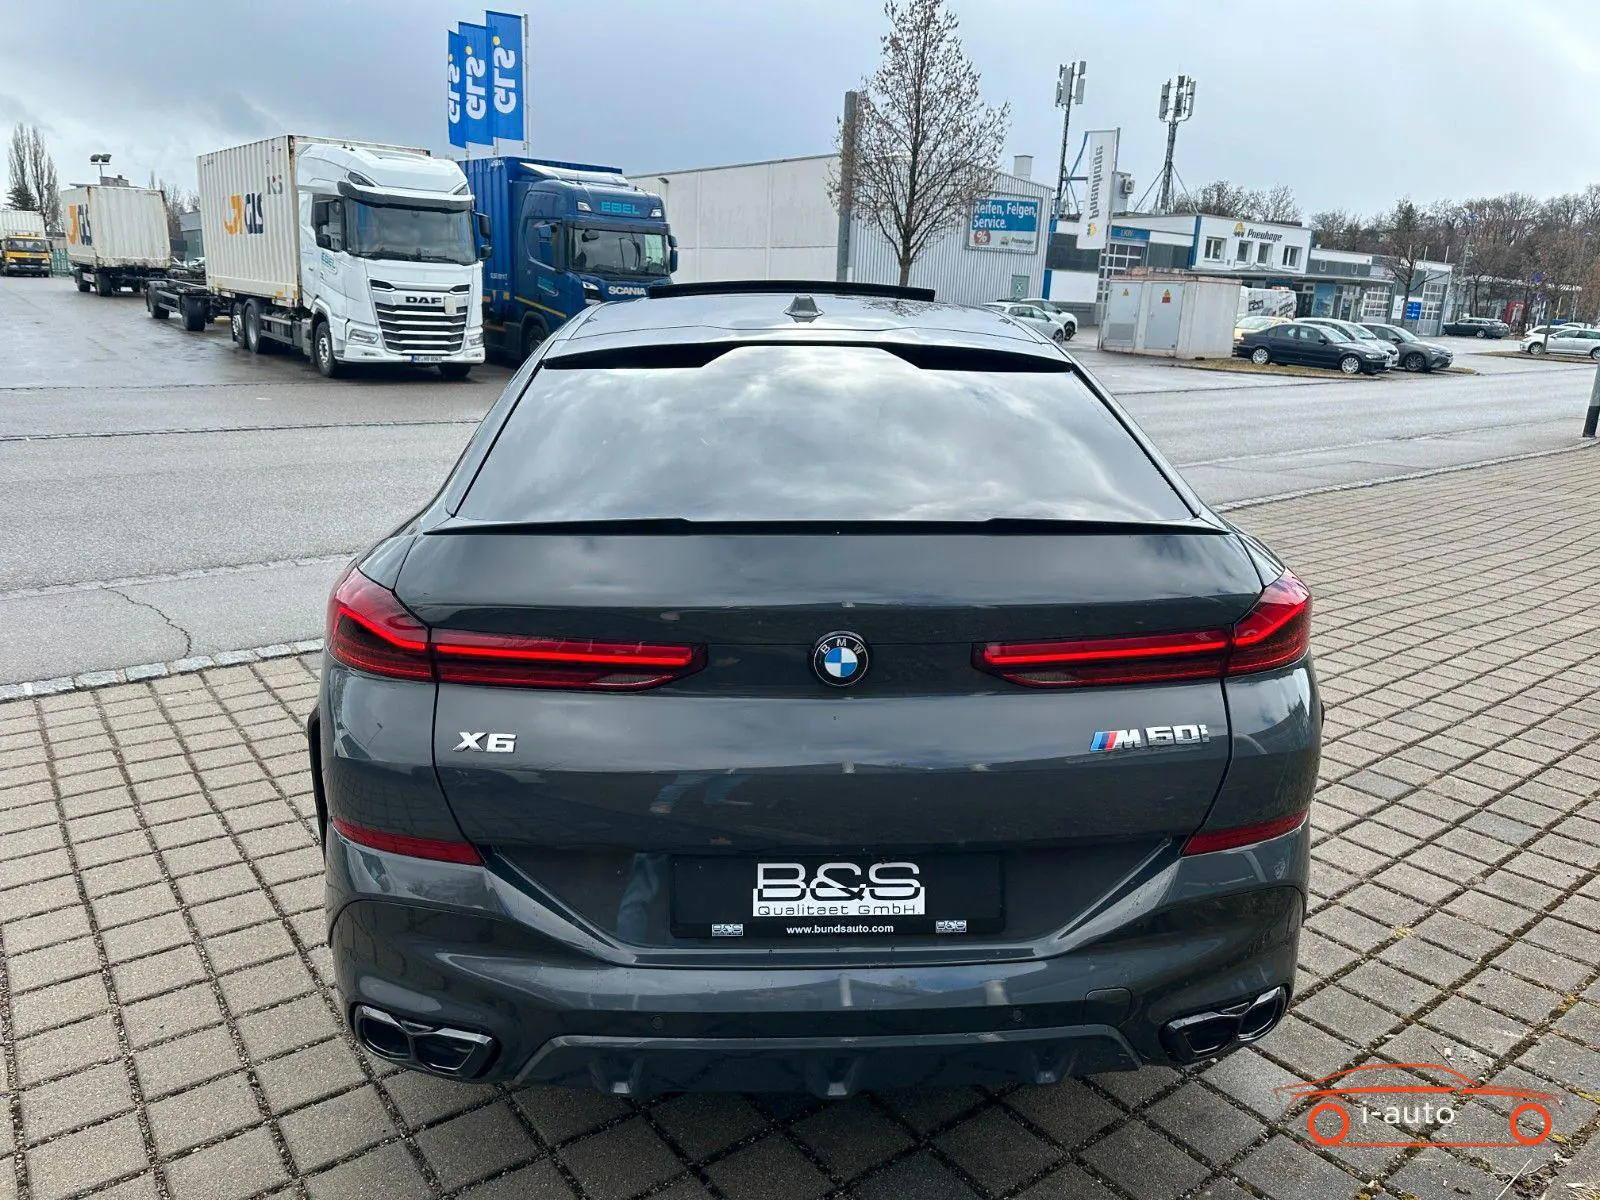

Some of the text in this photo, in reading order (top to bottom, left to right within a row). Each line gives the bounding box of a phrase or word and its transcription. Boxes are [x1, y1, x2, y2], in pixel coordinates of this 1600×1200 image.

[600, 201, 641, 215] EBEL
[974, 200, 1037, 219] Reifen, Felgen,
[973, 214, 1007, 229] Service.
[1247, 228, 1283, 243] Pneuhage
[608, 285, 647, 296] SCANIA
[405, 296, 443, 305] DAF
[820, 638, 864, 655] BMW
[452, 731, 517, 754] X6
[757, 861, 921, 902] B&S
[757, 903, 849, 916] Qualitaet
[786, 923, 894, 934] www.bundsauto.com
